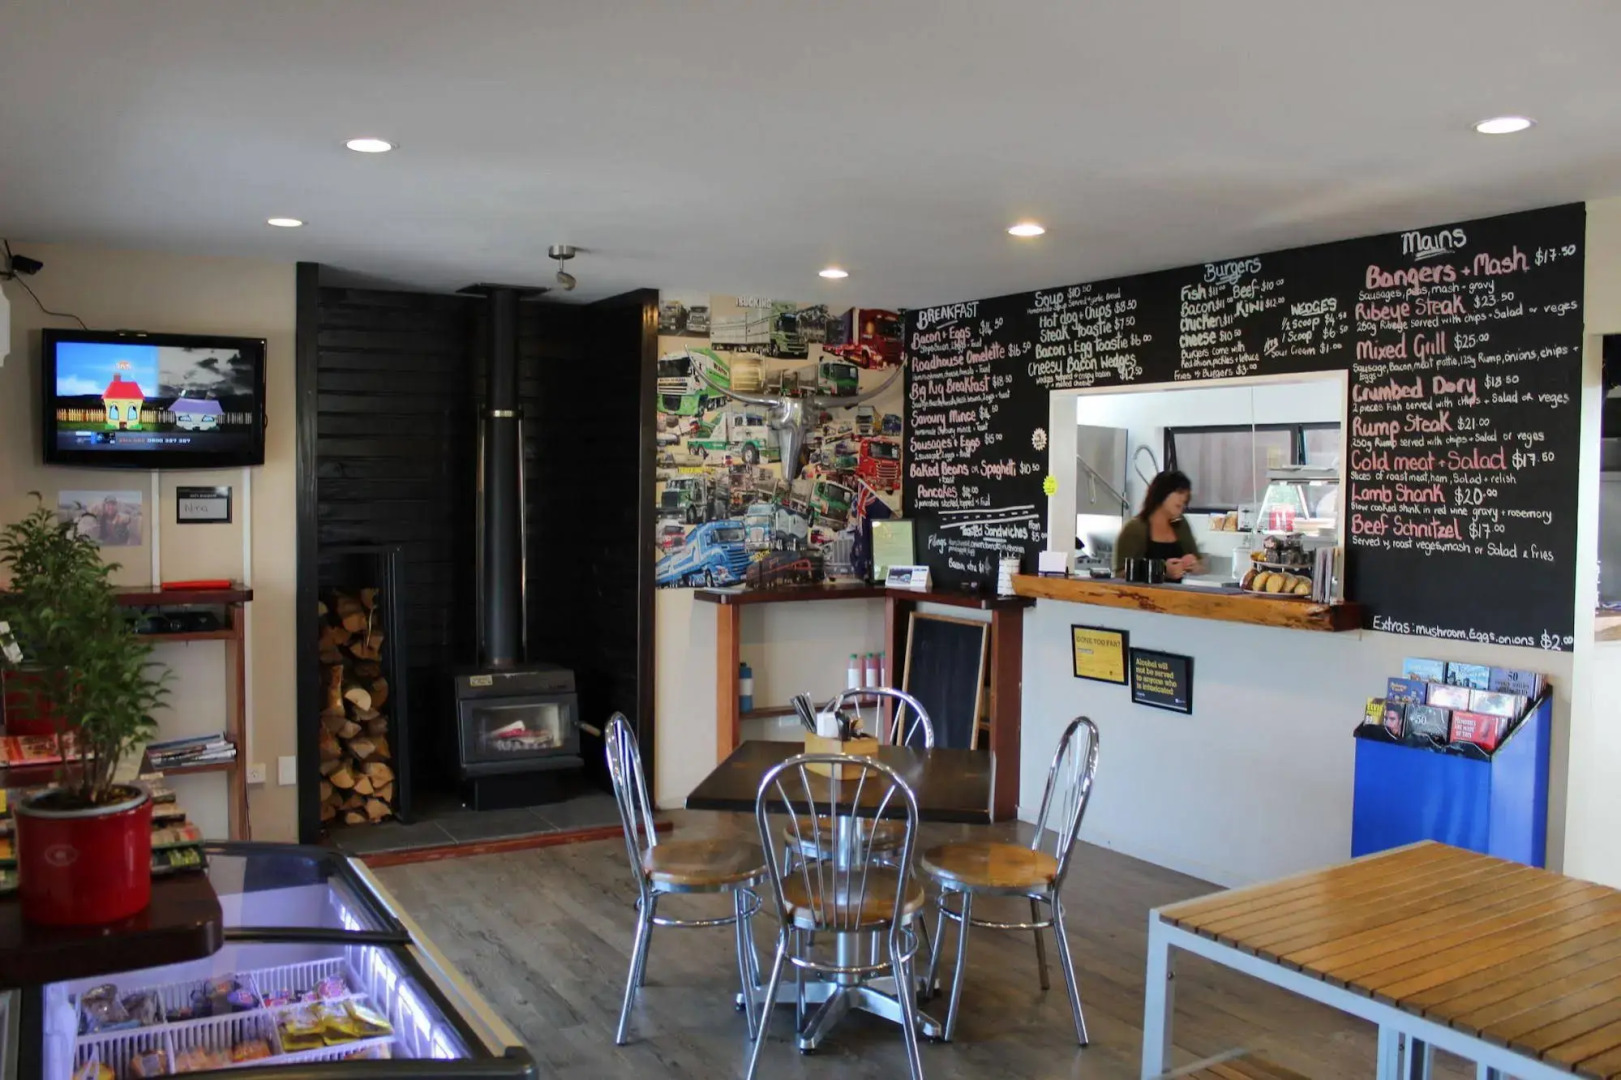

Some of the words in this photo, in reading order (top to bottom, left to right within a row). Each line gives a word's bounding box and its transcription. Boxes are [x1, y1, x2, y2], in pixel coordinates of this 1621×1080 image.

[1402, 228, 1467, 254] Mains
[1204, 257, 1261, 285] Burgers
[1365, 264, 1457, 294] Bangers
[1474, 245, 1530, 276] Mash
[1181, 283, 1206, 301] Fish
[1233, 279, 1260, 299] Beef
[1469, 280, 1495, 294] gravy
[1034, 291, 1064, 309] Soup
[1181, 302, 1216, 317] Bacon
[1291, 298, 1337, 315] WEDGES
[1355, 302, 1410, 326] Ribeye
[1415, 294, 1467, 316] Steak
[917, 301, 979, 330] BREAKFAST
[1039, 312, 1058, 328] Hot
[1441, 314, 1461, 324] with
[1464, 314, 1487, 325] chips
[1494, 302, 1523, 319] Salad
[1544, 301, 1577, 316] veges
[911, 331, 941, 350] Bacon
[949, 326, 971, 345] Eggs
[1040, 323, 1070, 342] Steak
[912, 354, 964, 372] Roadhouse
[966, 341, 1005, 364] Omelette
[1035, 343, 1066, 359] Bacon
[1074, 340, 1093, 358] Egg
[1212, 346, 1229, 355] come
[1356, 332, 1408, 360] Mixed
[1414, 331, 1447, 362] Grill
[1540, 344, 1567, 358] chips
[1028, 359, 1063, 377] Cheesy
[1067, 356, 1098, 374] Bacon
[1100, 352, 1137, 371] Wedges
[1174, 370, 1192, 380] Fries
[1202, 368, 1233, 378] Burgers
[909, 382, 926, 402] Big
[946, 374, 990, 393] Breakfast
[1352, 376, 1424, 402] Crumbed
[1432, 376, 1476, 404] Dory
[1436, 396, 1453, 408] with
[1492, 390, 1518, 403] Salad
[1538, 393, 1570, 408] veges
[911, 410, 946, 430] Savoury
[949, 410, 977, 423] Mince
[1353, 416, 1400, 446] Rump
[1404, 409, 1453, 432] Steak
[910, 437, 952, 453] Sausages
[960, 435, 981, 452] Eggs
[1427, 435, 1442, 445] with
[1475, 428, 1497, 442] Salad
[1517, 431, 1545, 448] veges
[1351, 449, 1390, 471] Cold
[1394, 450, 1435, 471] meat
[1447, 445, 1507, 471] Salad
[910, 463, 940, 477] Baked
[941, 461, 969, 476] Beans
[980, 459, 1016, 480] Spaghetti
[1376, 470, 1385, 480] of
[1386, 471, 1407, 482] roast
[1453, 472, 1482, 484] Salad
[1491, 472, 1517, 484] relish
[917, 484, 958, 498] Pancakes
[1352, 482, 1392, 502] Lamb
[1396, 483, 1445, 502] Shank
[1371, 502, 1397, 513] cooked
[1423, 505, 1430, 514] in
[1434, 504, 1446, 514] red
[1450, 507, 1468, 515] wine
[1472, 507, 1498, 522] gravy
[1508, 510, 1552, 525] rosemary
[960, 524, 982, 537] Toasted
[984, 523, 1029, 539] Sandwiches
[1352, 513, 1389, 536] Beef
[1393, 514, 1462, 540] Schnitzel
[1352, 535, 1380, 547] Served
[1393, 538, 1412, 548] roast
[1488, 542, 1517, 558] Salad
[1531, 544, 1554, 561] fries
[1499, 636, 1534, 645] onions
[1136, 658, 1157, 667] Alcohol
[1508, 671, 1519, 681] 50
